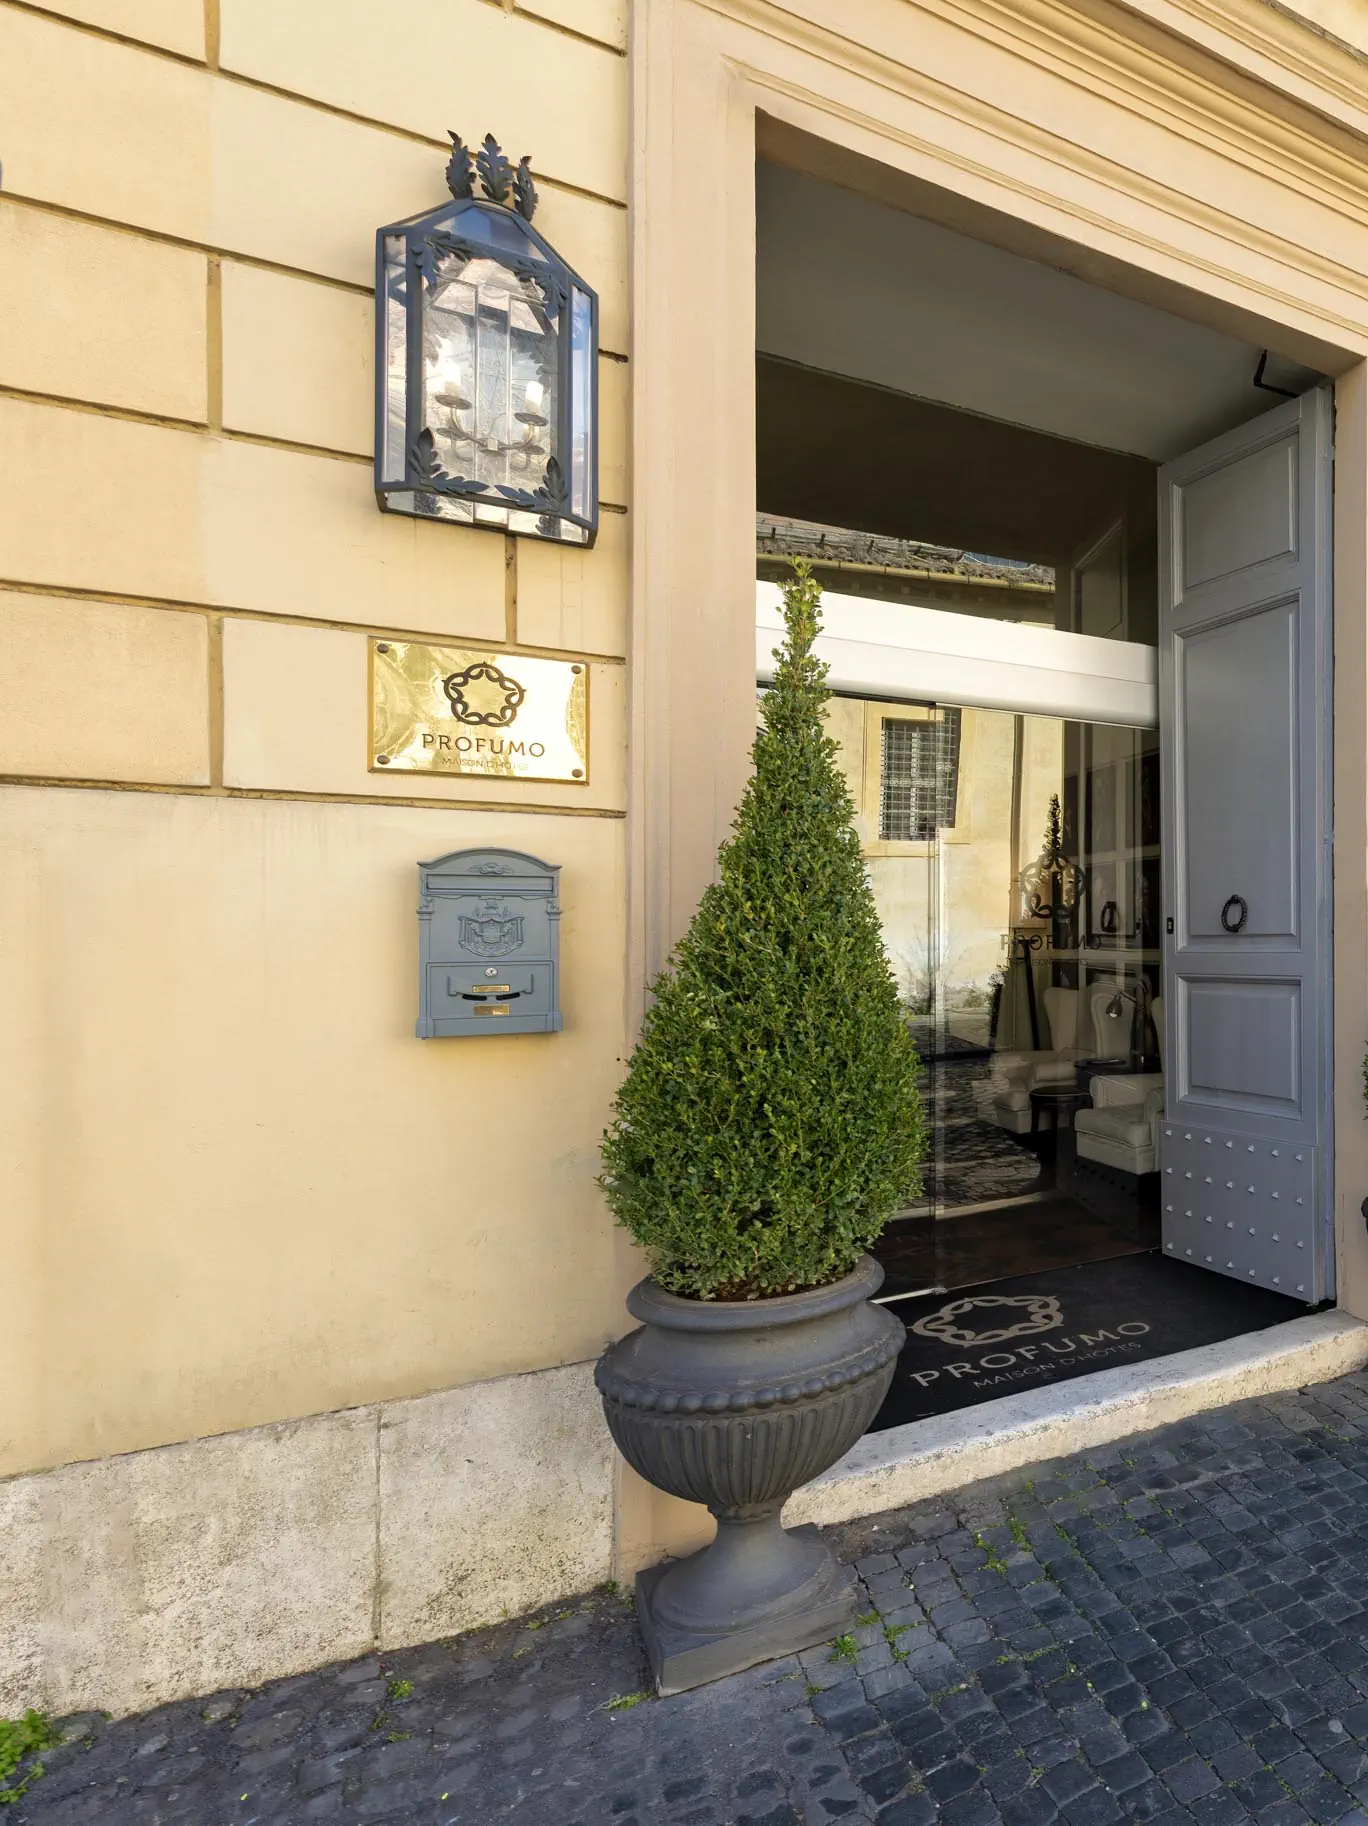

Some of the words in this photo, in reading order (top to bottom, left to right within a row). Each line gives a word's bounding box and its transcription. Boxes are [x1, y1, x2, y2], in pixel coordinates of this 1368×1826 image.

[421, 733, 546, 758] PROFUMO
[442, 757, 484, 768] MAISON
[910, 1322, 1151, 1388] PROFUMO
[972, 1362, 1056, 1389] MAISON
